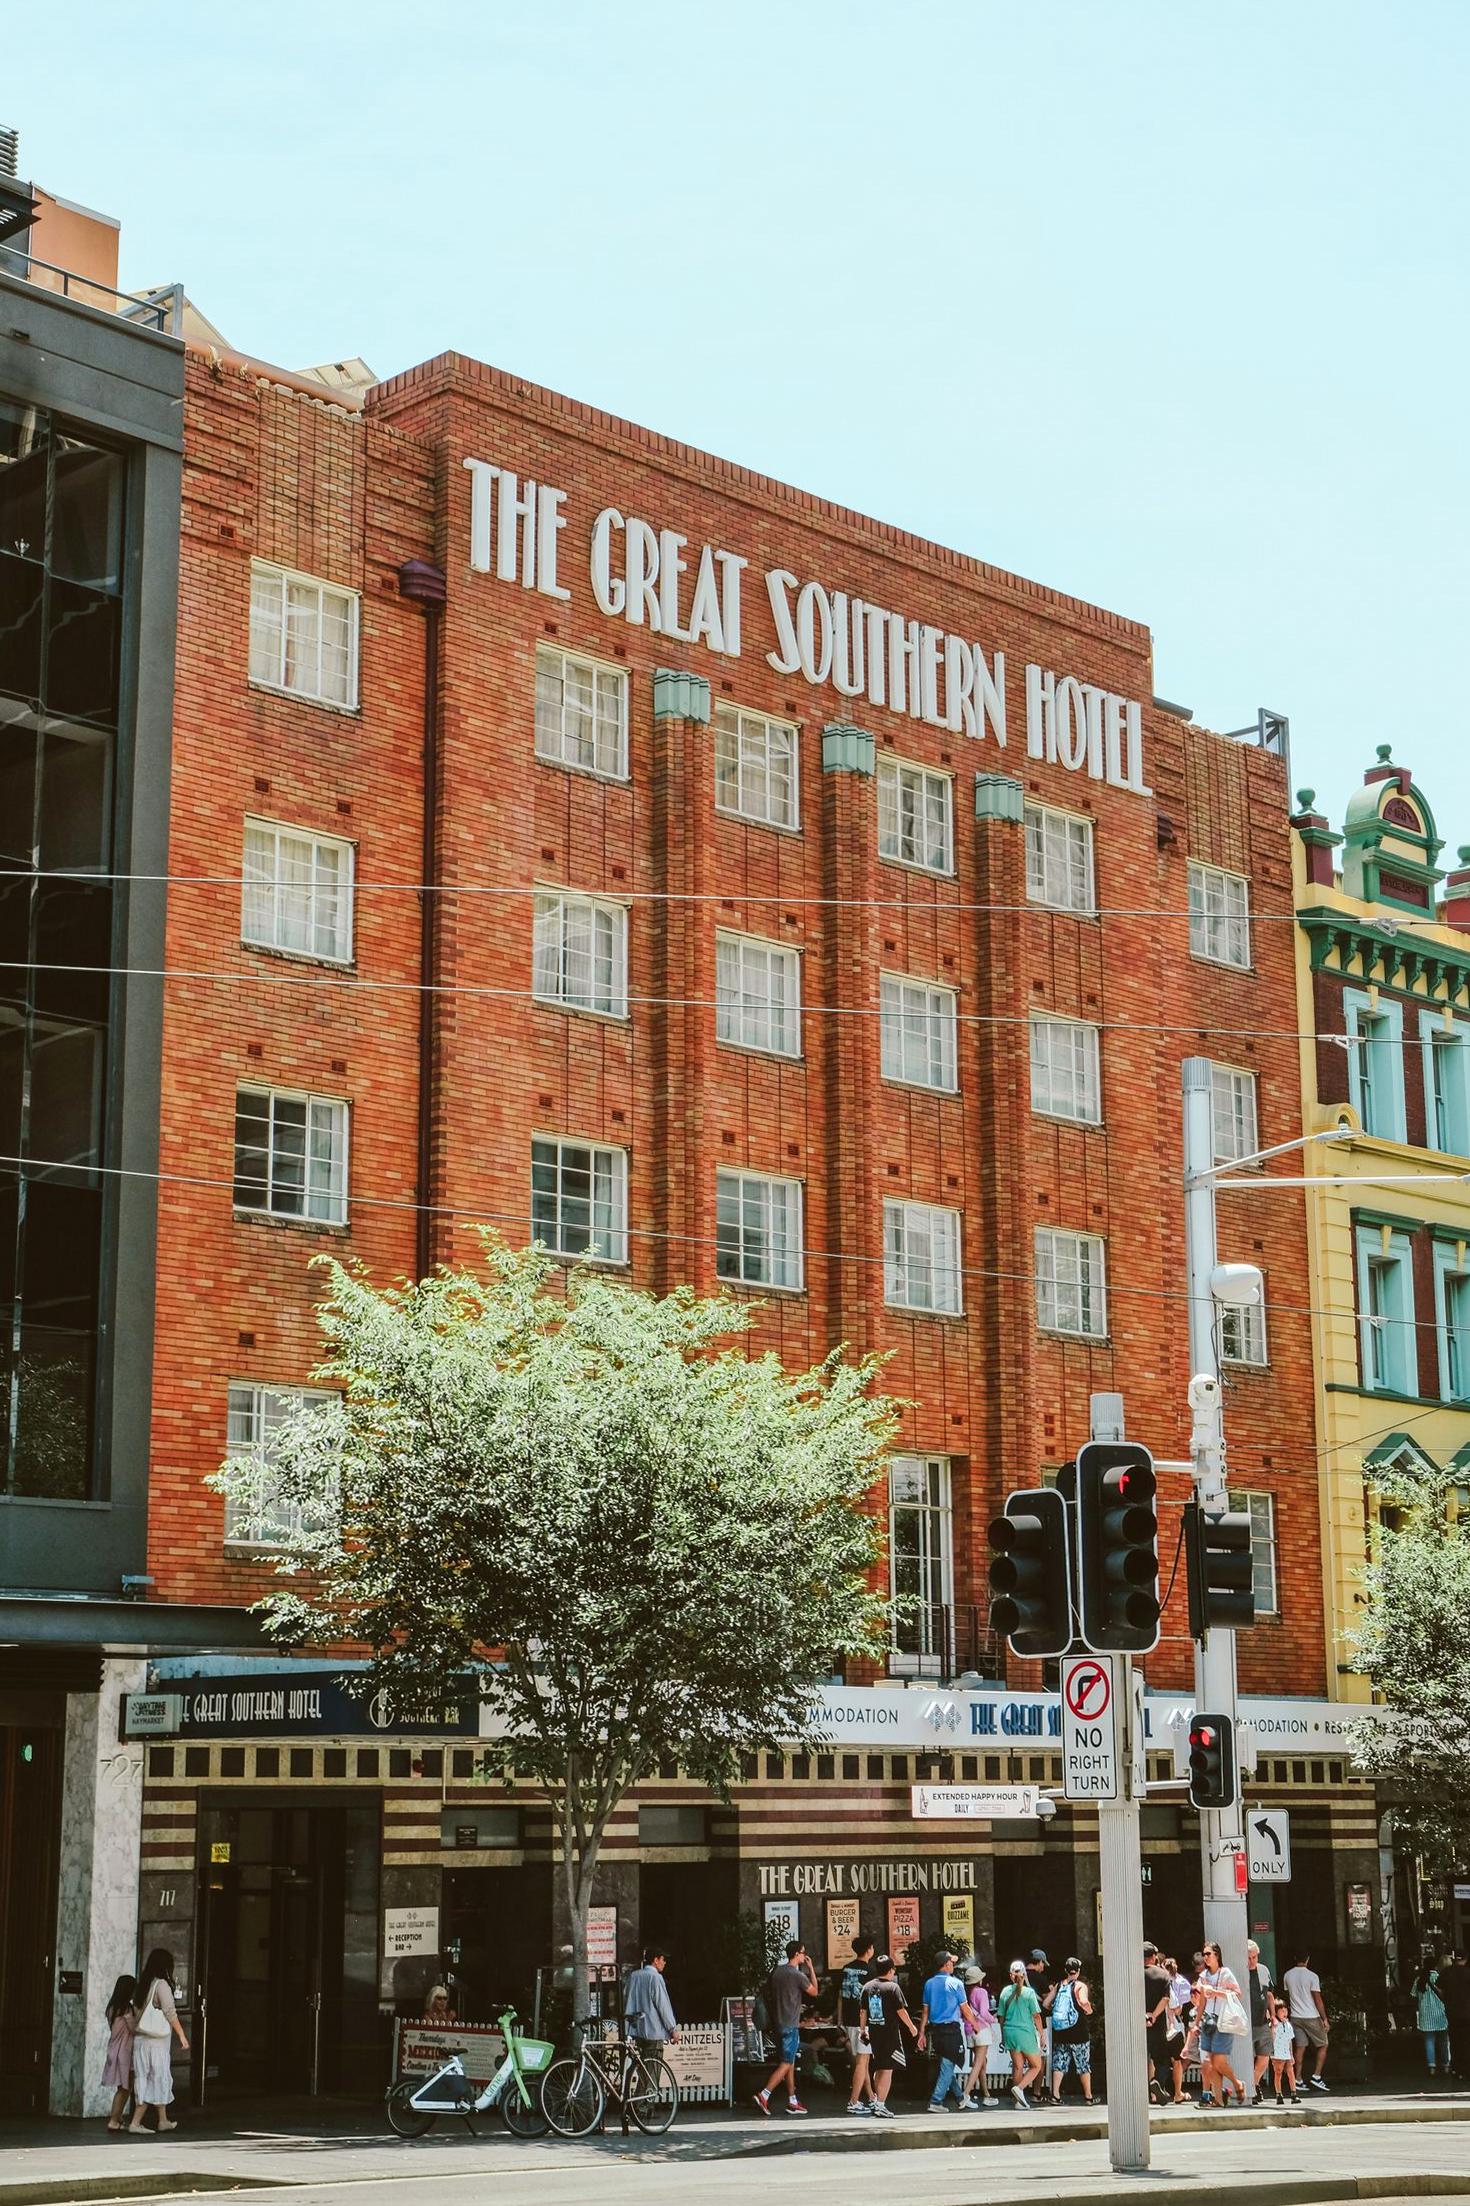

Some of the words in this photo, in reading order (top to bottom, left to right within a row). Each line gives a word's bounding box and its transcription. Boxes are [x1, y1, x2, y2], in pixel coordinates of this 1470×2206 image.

[462, 457, 571, 600] THE
[591, 507, 748, 657] GREAT
[765, 568, 1007, 748] SOUTHERN
[1026, 663, 1153, 797] HOTEL
[193, 1693, 228, 1722] GREAT
[231, 1691, 284, 1721] SOUTHERN
[288, 1690, 322, 1719] HOTEL
[970, 1703, 997, 1735] THE
[1000, 1703, 1044, 1736] GREAT
[1075, 1728, 1103, 1748] NO
[1069, 1755, 1110, 1769] RIGHT
[100, 1754, 144, 1787] 727
[1072, 1776, 1110, 1790] TURN
[932, 1793, 970, 1801] EXTENDED
[971, 1793, 995, 1801] HAPPY
[955, 1804, 970, 1813] DAILY
[1252, 1861, 1286, 1874] ONLY
[759, 1865, 790, 1895] THE
[793, 1863, 844, 1894] GREAT
[850, 1863, 928, 1892] SOUTHERN
[933, 1862, 978, 1890] HOTEL
[160, 1889, 176, 1906] 717
[395, 1933, 422, 1941] RECEPTION
[834, 1924, 850, 1936] $24
